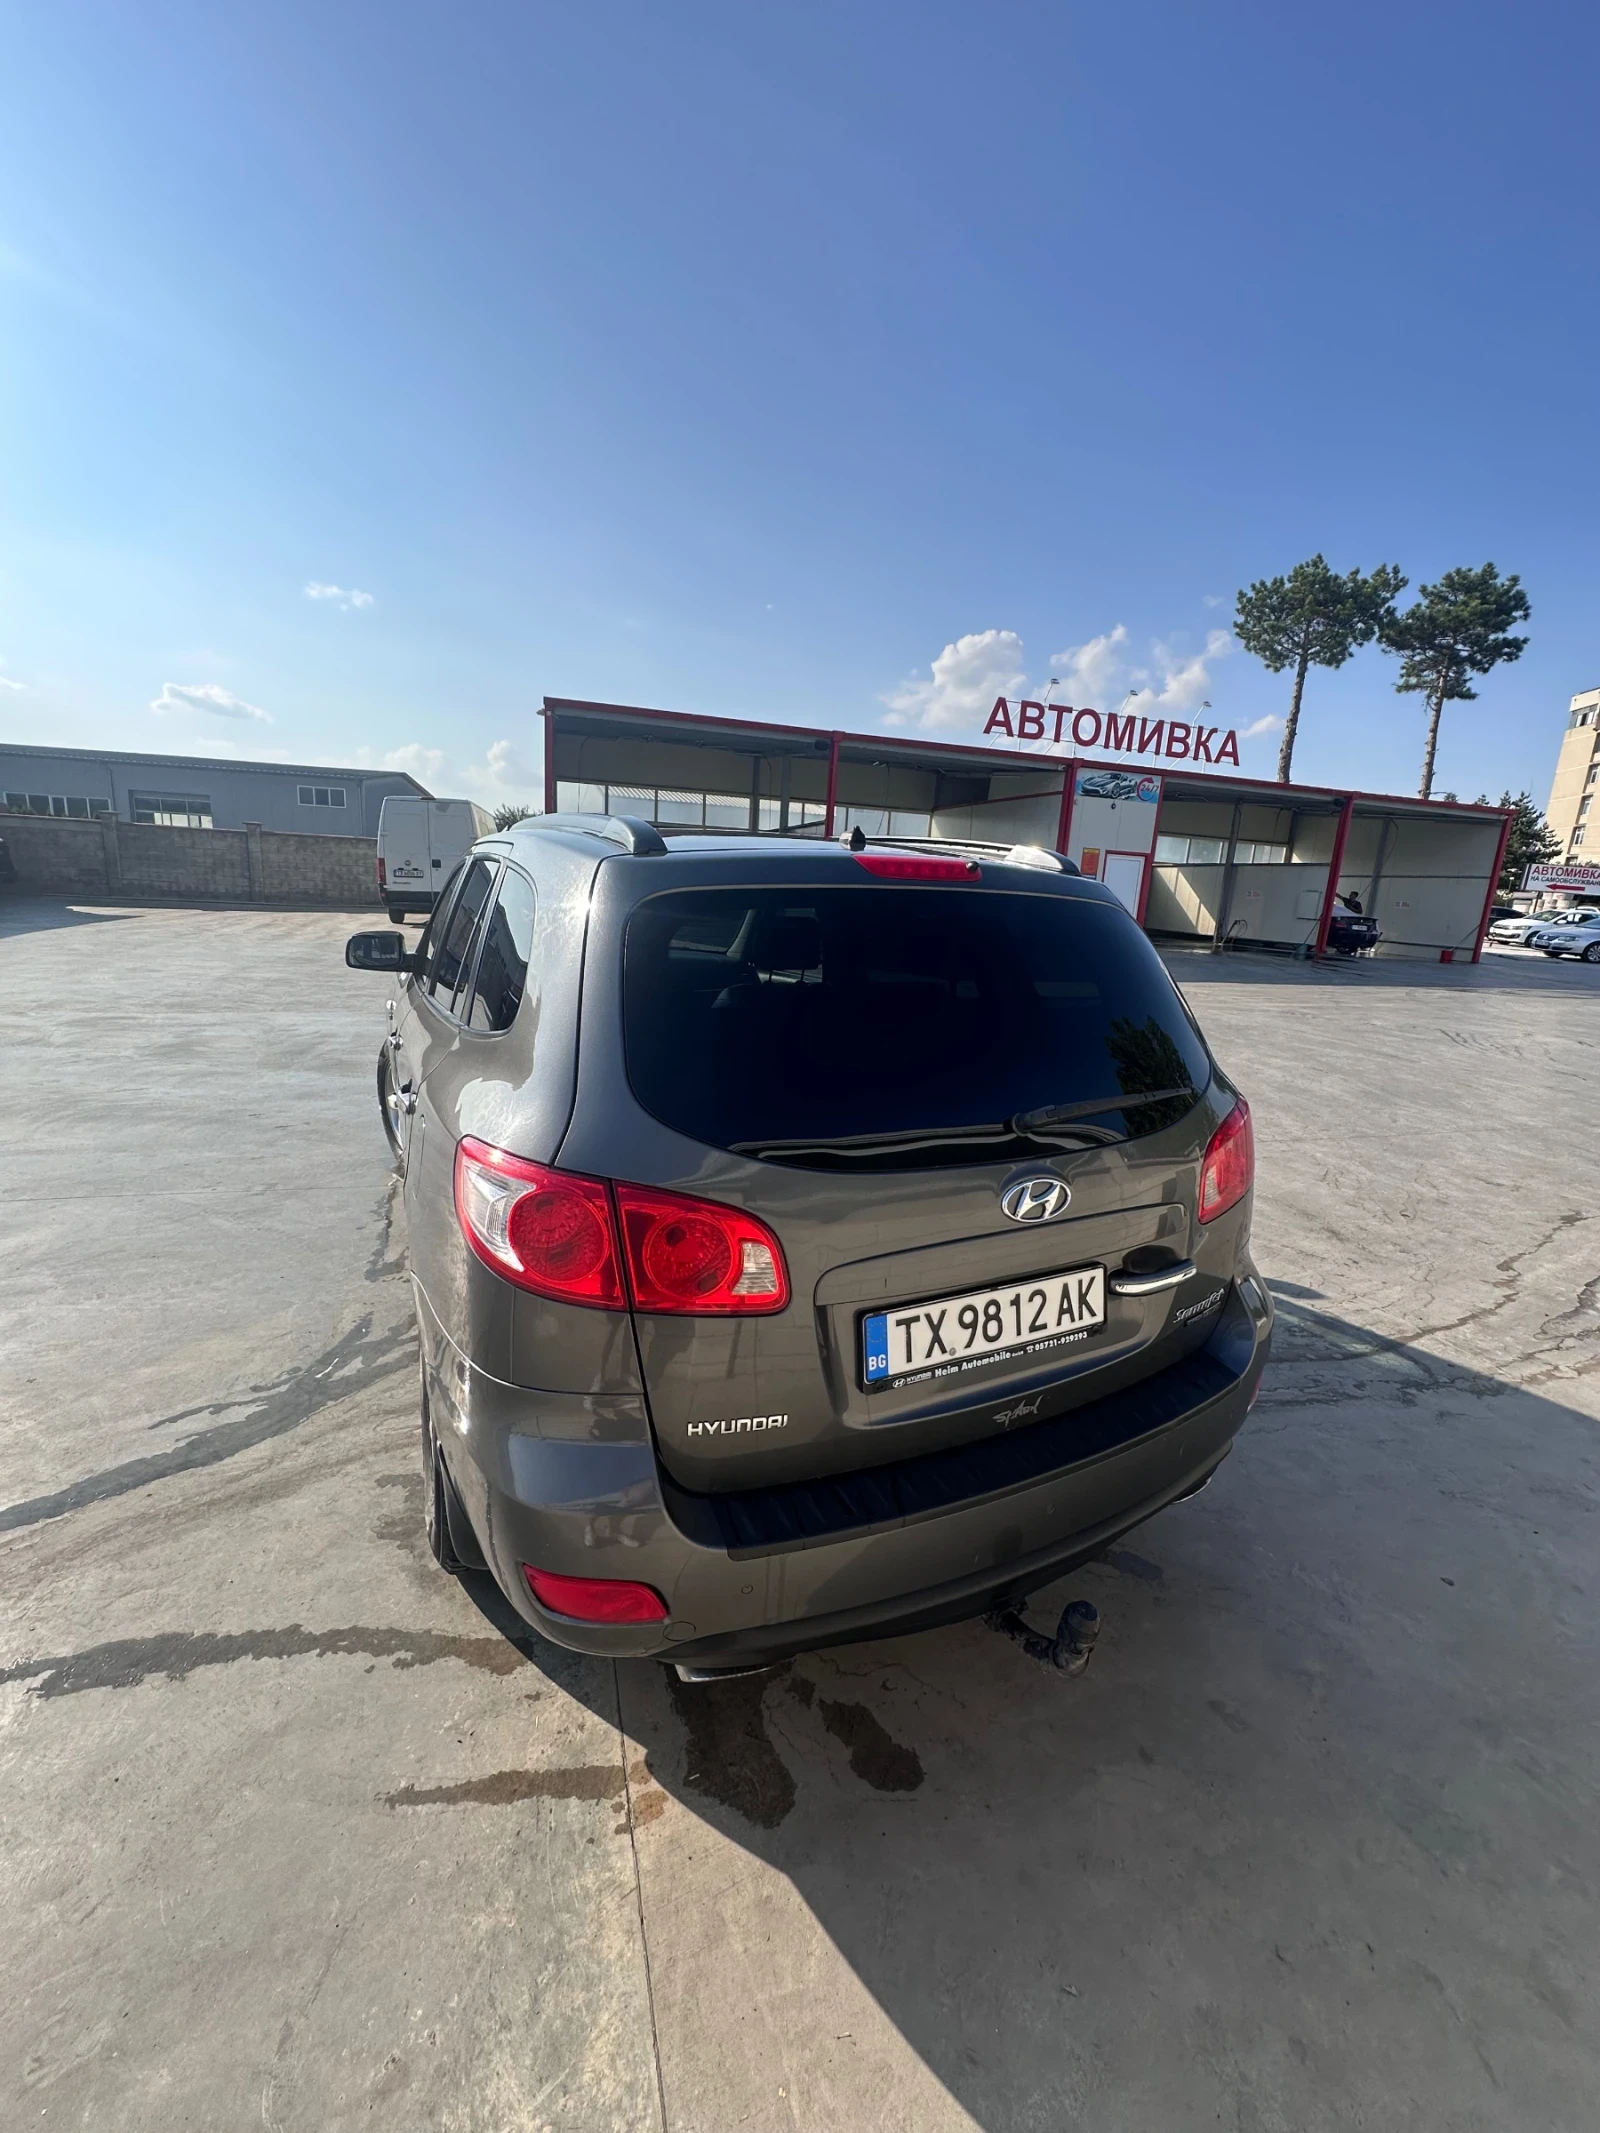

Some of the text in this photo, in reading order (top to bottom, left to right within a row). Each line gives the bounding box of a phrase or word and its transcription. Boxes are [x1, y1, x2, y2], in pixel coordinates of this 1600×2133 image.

[983, 697, 1240, 766] АВТОМИВКА
[958, 1289, 1048, 1349] 9812
[868, 1354, 887, 1370] BG
[935, 1365, 959, 1377] Heim
[961, 1351, 1011, 1371] Automobile
[687, 1414, 788, 1436] HYUNDAI
